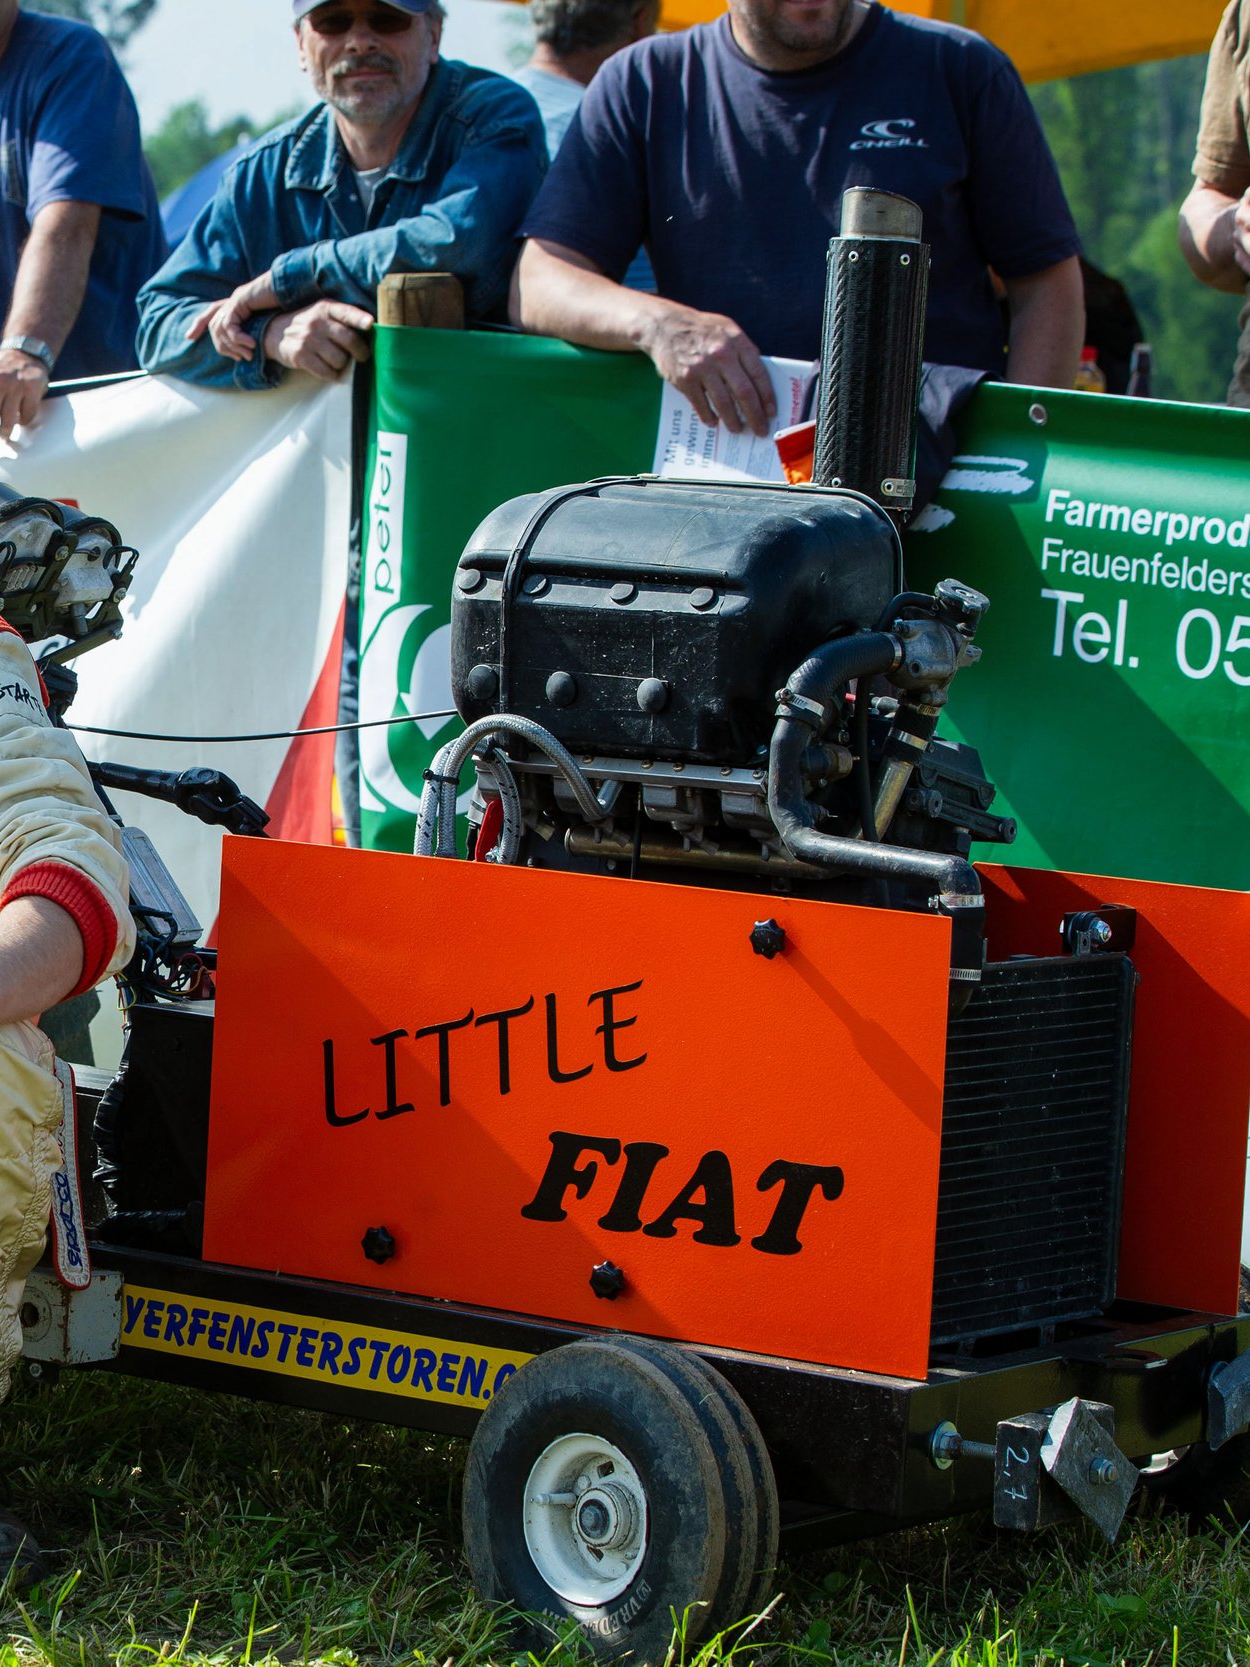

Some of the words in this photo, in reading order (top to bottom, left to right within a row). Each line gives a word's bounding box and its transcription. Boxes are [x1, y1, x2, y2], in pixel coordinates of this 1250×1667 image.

[671, 409, 683, 436] uns
[1040, 588, 1140, 669] Tel.
[1176, 608, 1250, 687] 05
[322, 978, 648, 1128] LITTLE
[520, 1131, 845, 1256] FIAT
